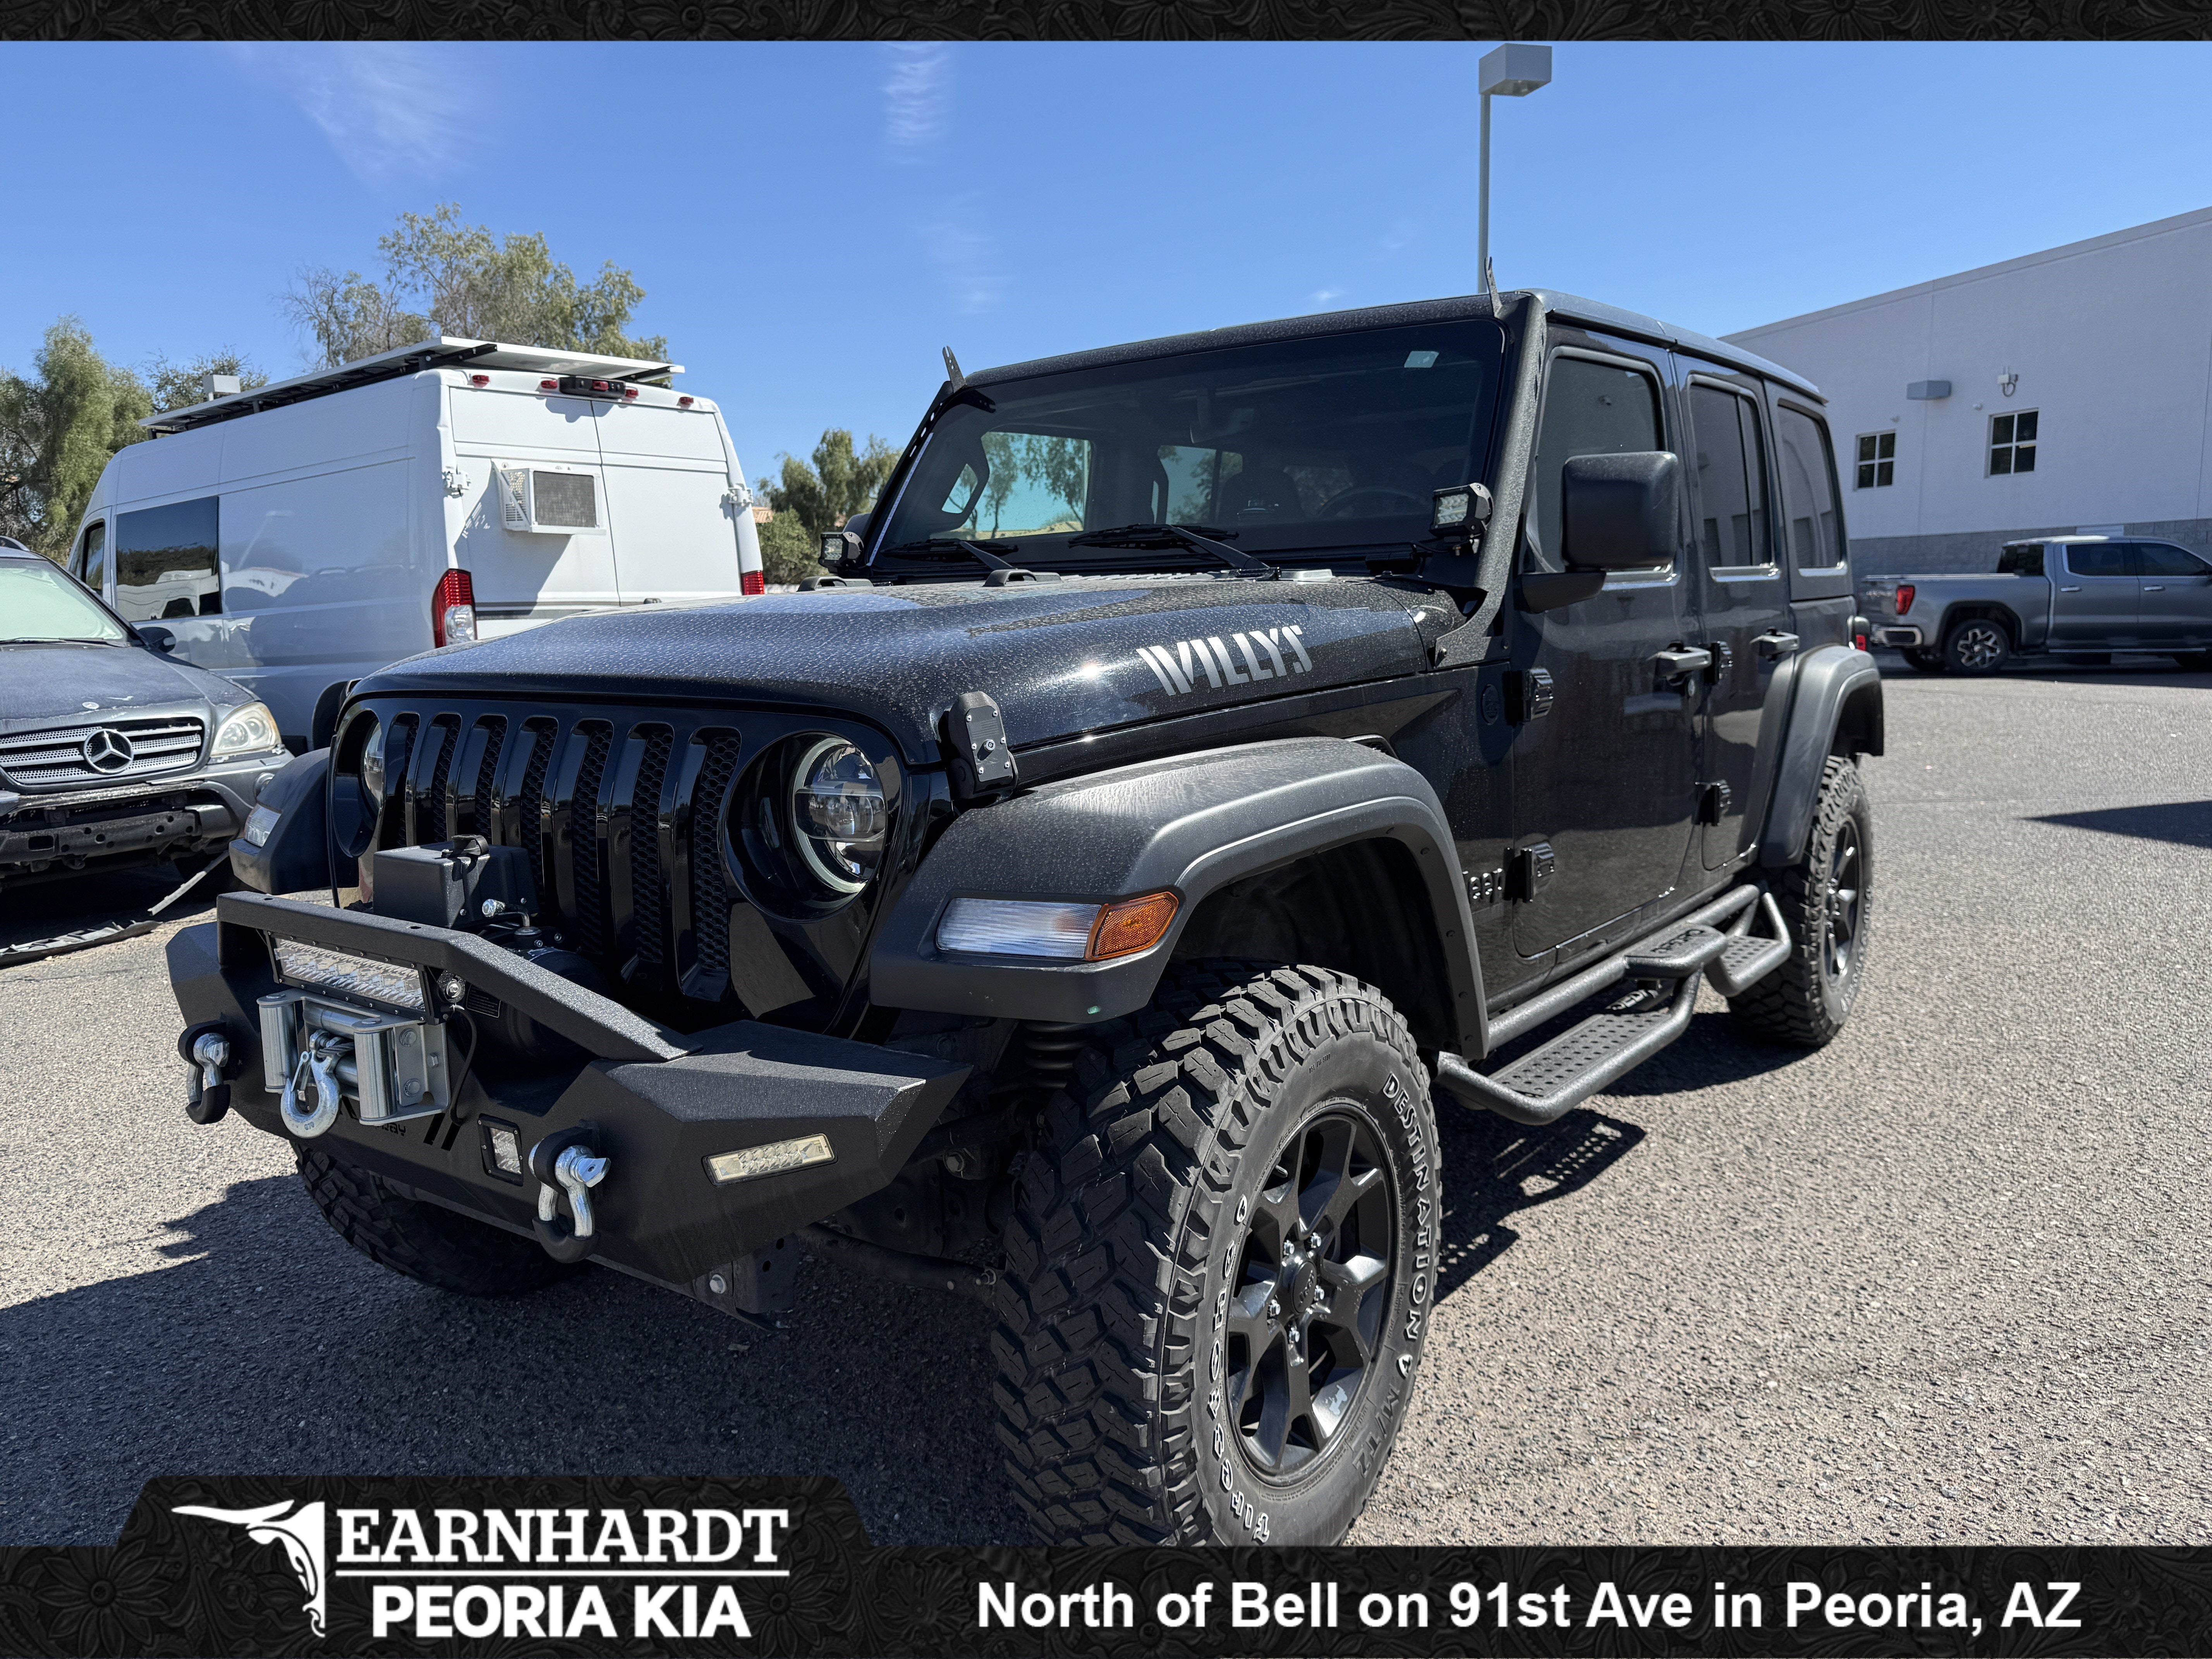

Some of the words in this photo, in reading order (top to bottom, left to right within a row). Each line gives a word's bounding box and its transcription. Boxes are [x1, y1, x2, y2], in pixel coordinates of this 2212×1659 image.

[1136, 625, 1312, 696] WILLYS
[1463, 868, 1504, 903] eep
[1382, 1072, 1431, 1342] DESTINATION
